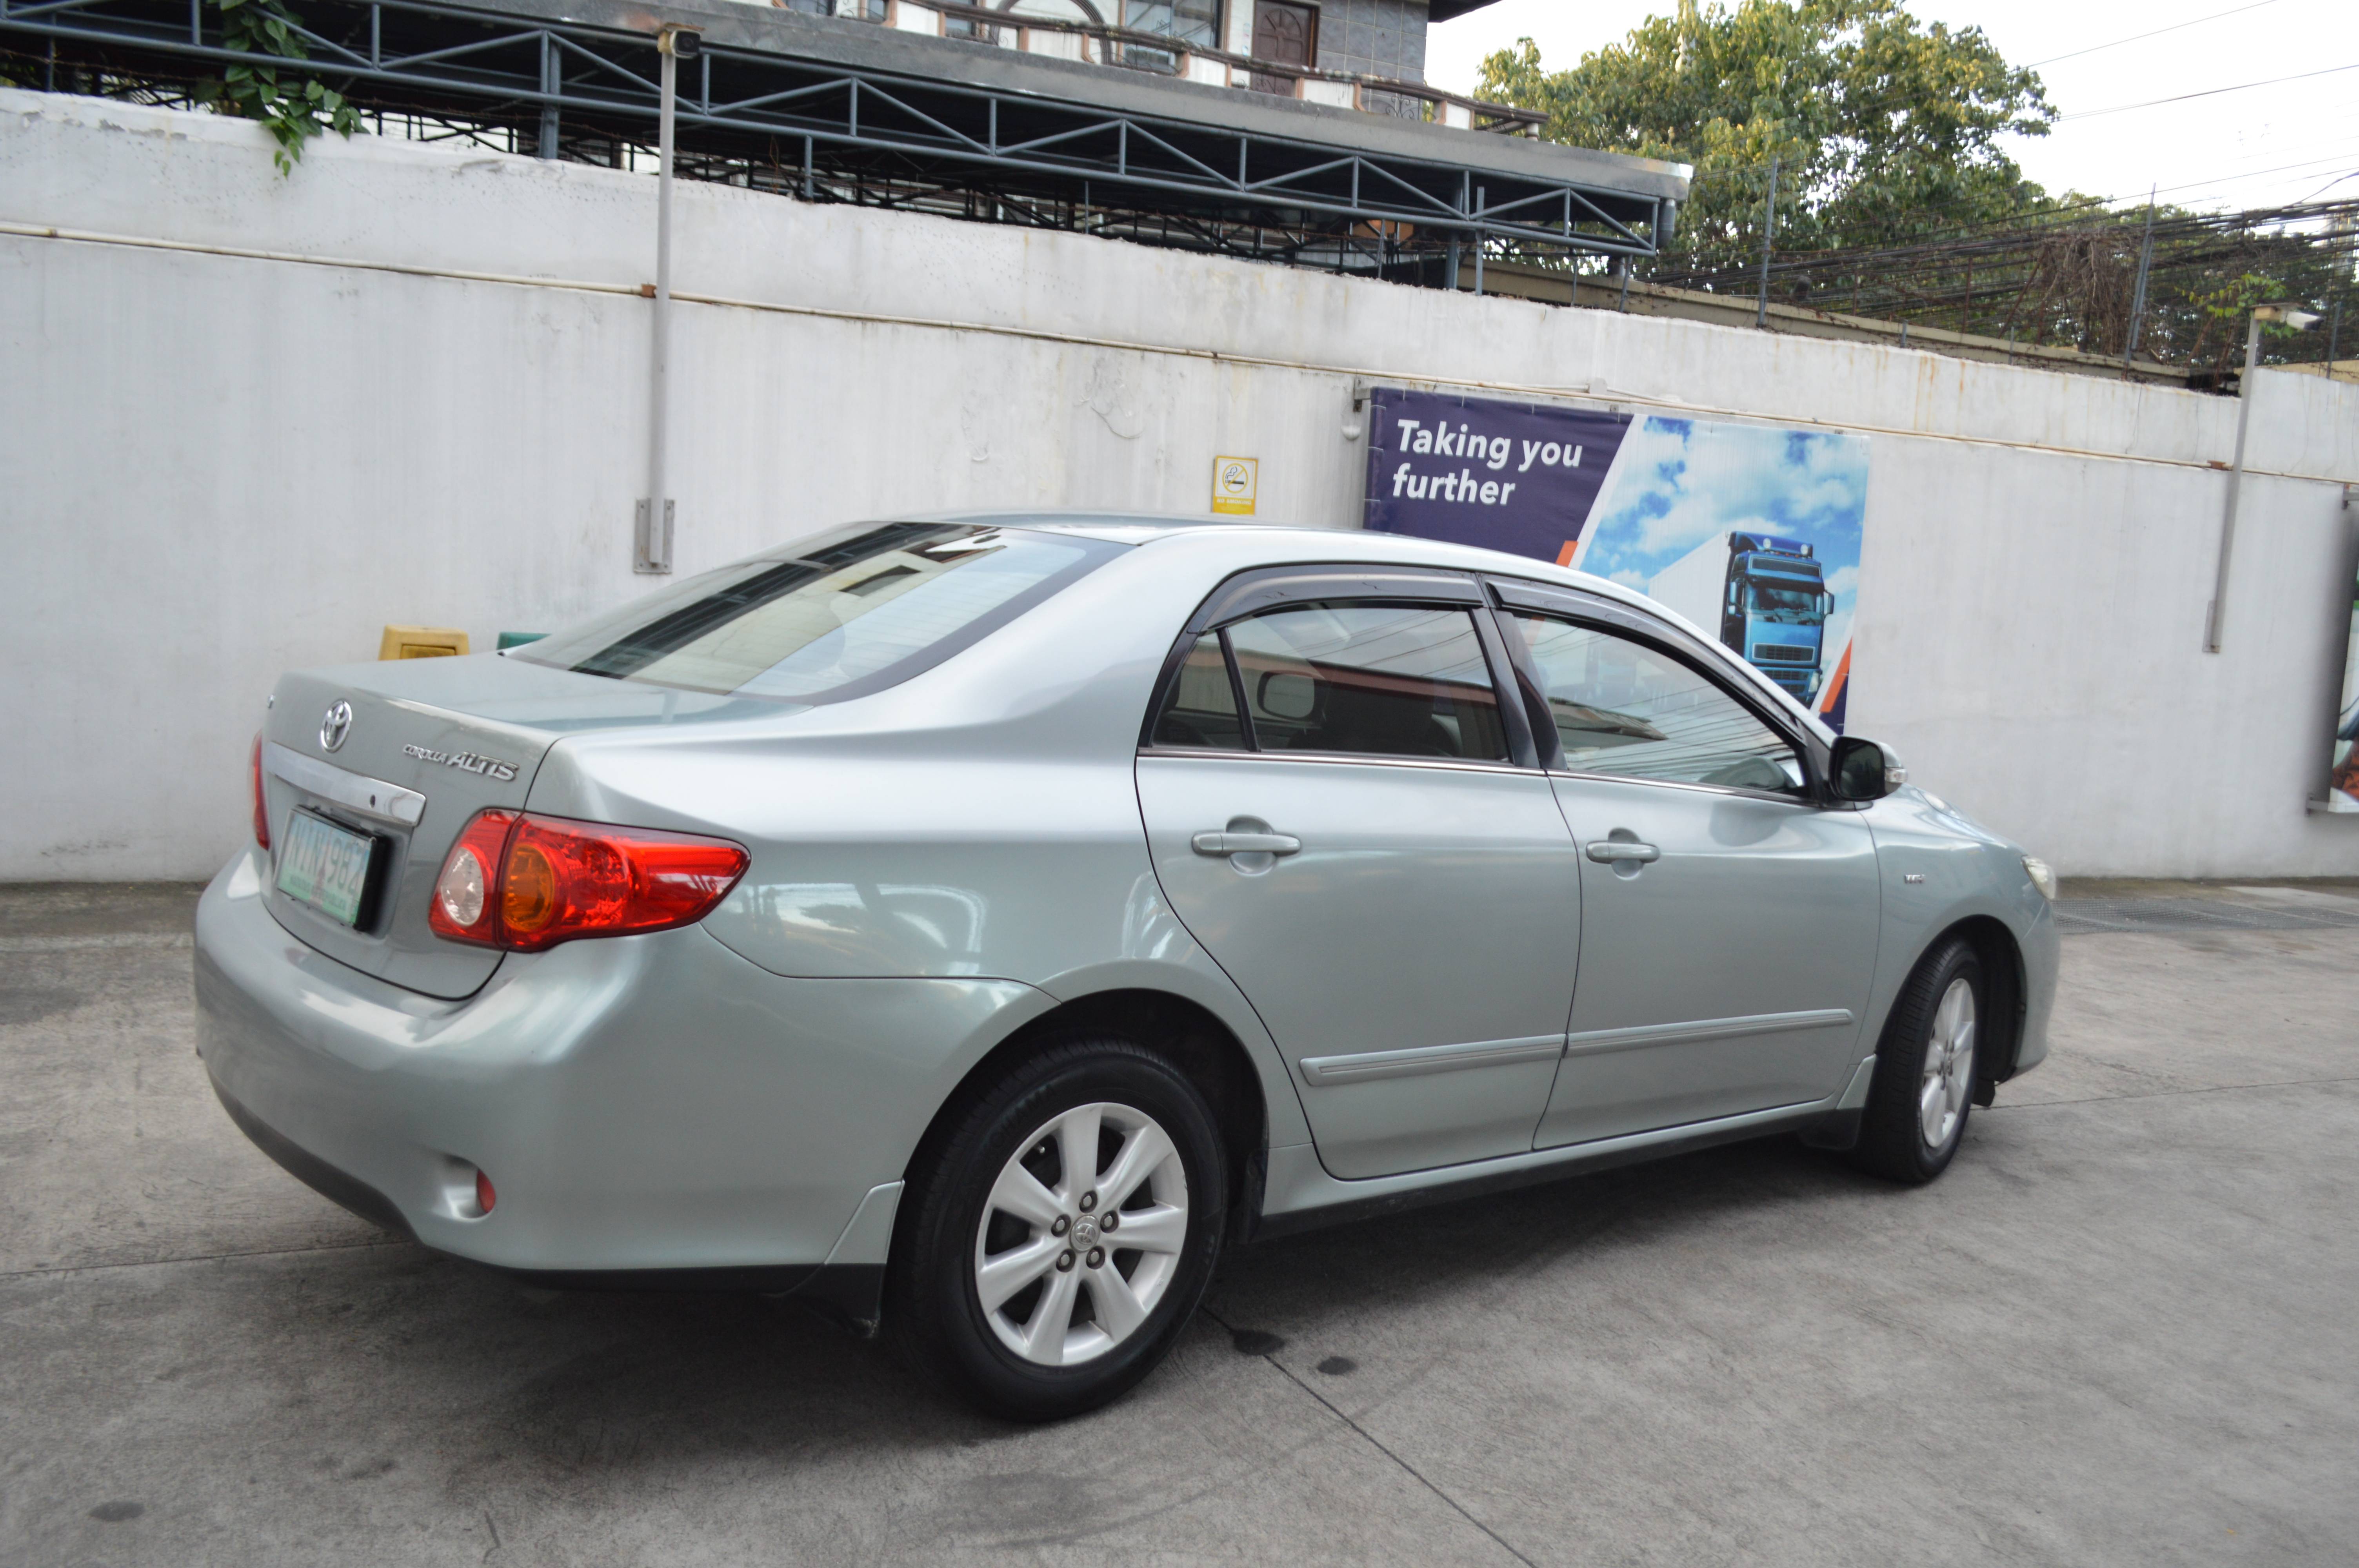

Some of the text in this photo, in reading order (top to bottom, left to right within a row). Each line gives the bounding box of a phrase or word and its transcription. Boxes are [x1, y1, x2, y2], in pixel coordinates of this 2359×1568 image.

[1397, 419, 1583, 472] Taking you
[1393, 463, 1516, 506] further
[403, 744, 520, 781] COROLLA ALTIS
